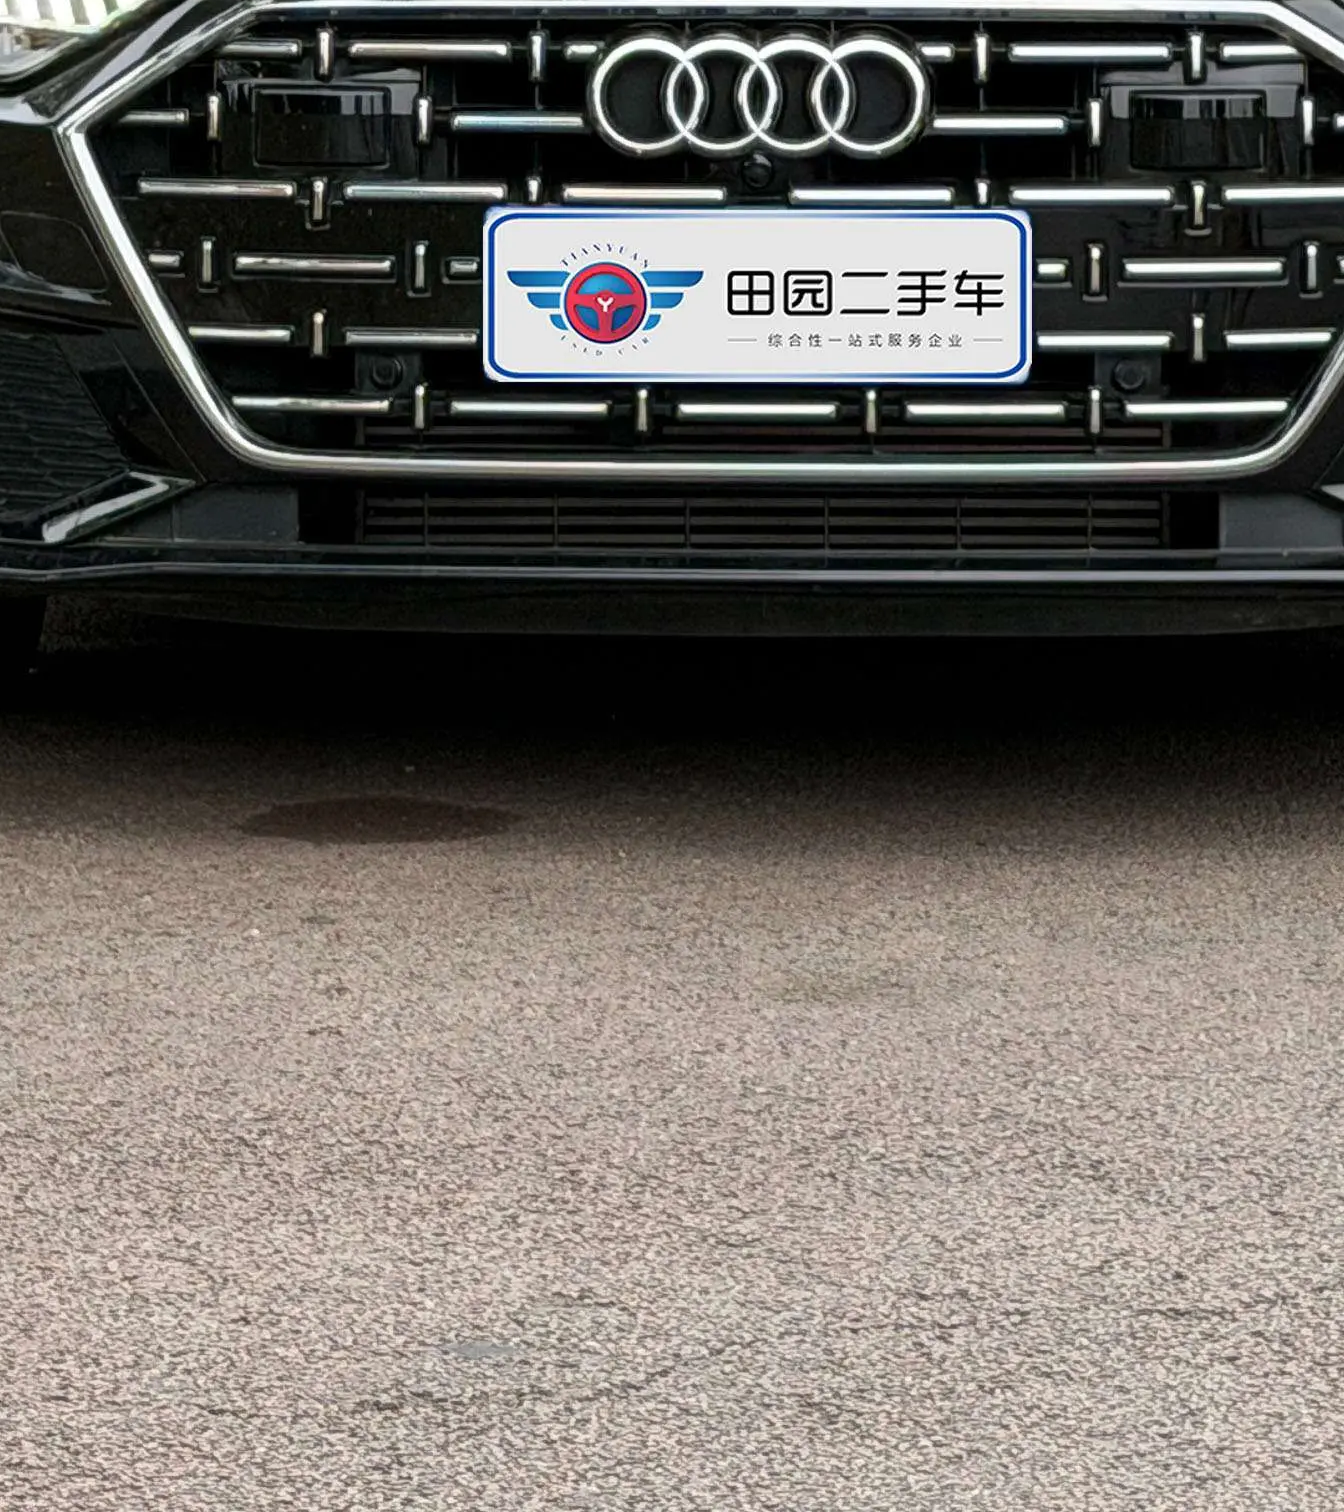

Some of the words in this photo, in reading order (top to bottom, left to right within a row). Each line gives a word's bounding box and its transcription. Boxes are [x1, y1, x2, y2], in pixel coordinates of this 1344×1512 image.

[727, 270, 1004, 316] 田园二手车
[767, 333, 963, 348] 综合性一站式服务企业
